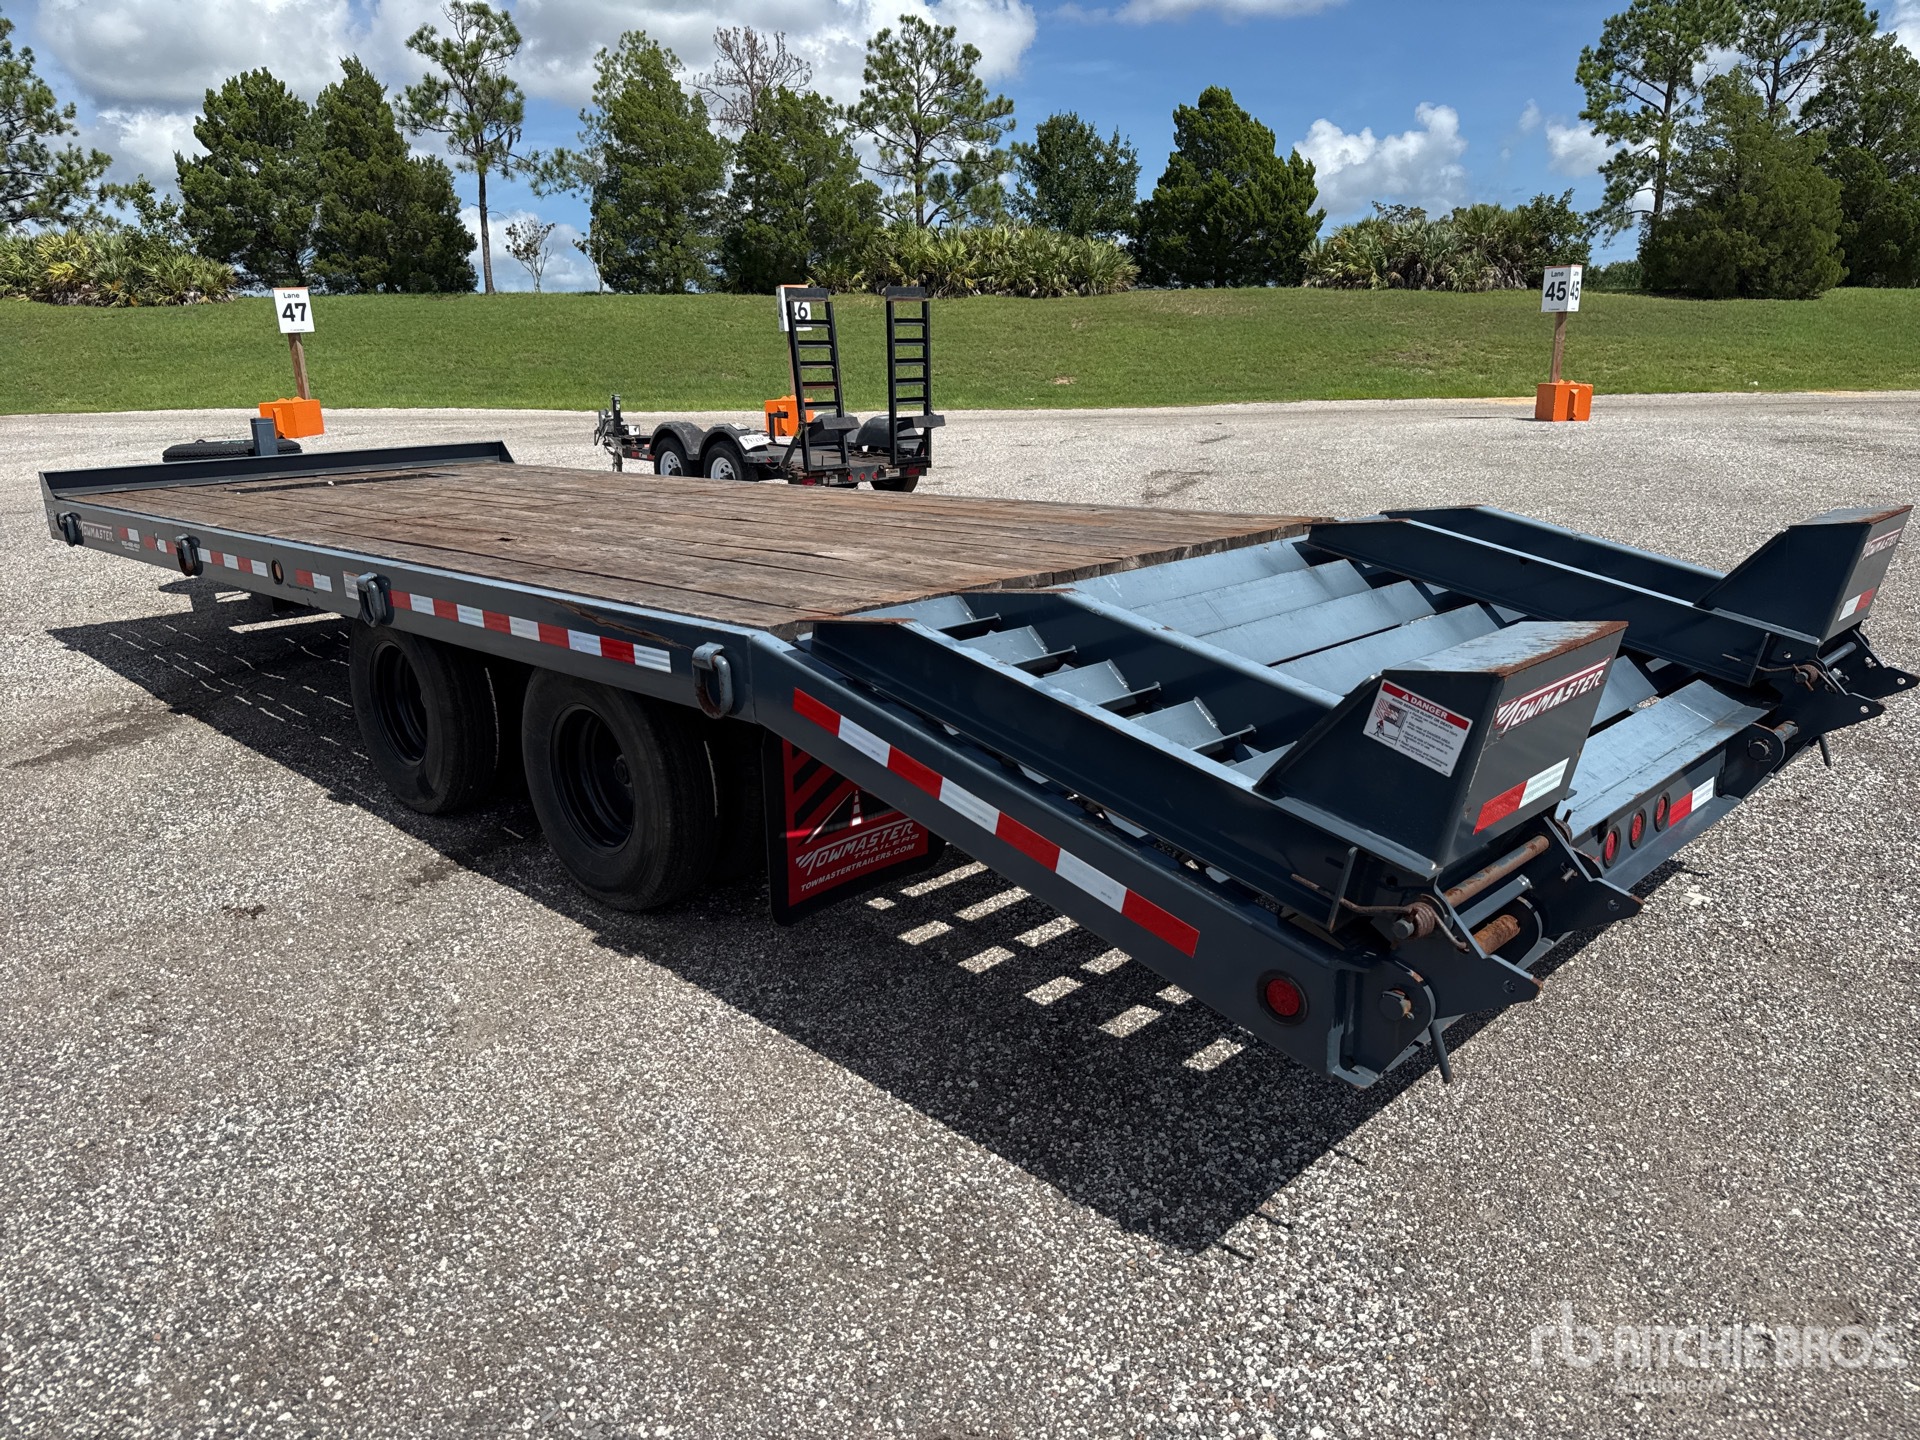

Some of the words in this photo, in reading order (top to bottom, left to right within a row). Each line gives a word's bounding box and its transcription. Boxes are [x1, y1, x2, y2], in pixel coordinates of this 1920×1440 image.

[1545, 281, 1567, 301] 45
[1569, 280, 1580, 301] 45
[282, 303, 307, 322] 47
[1410, 696, 1448, 720] DANGER
[1496, 657, 1610, 734] TOWMASTER
[795, 817, 914, 877] TOWMASTER
[853, 833, 919, 860] TRAILERS
[801, 843, 915, 892] TOWMASTERTRAILERS.COM
